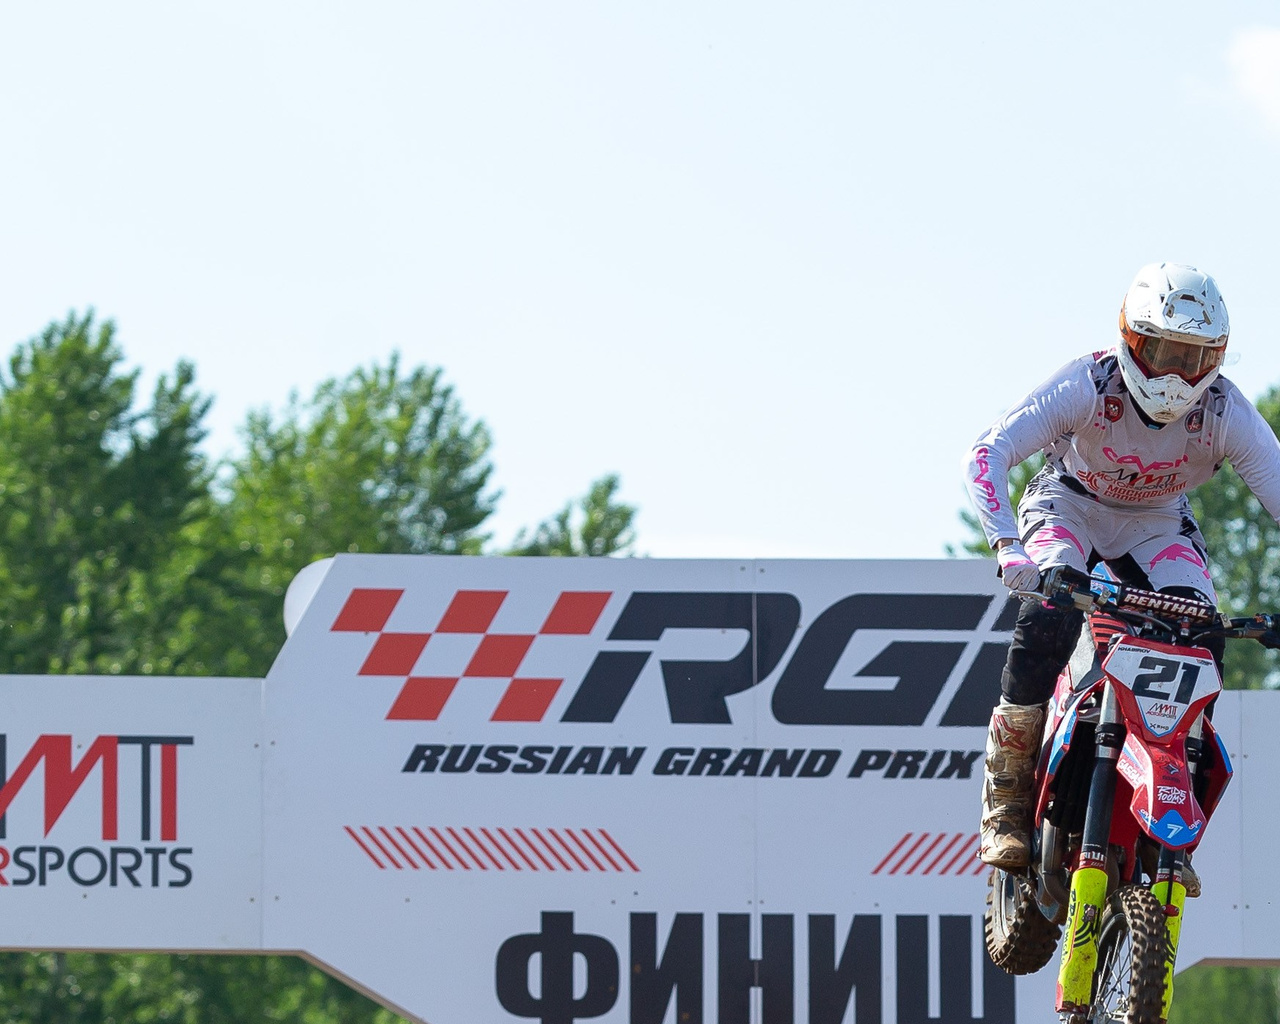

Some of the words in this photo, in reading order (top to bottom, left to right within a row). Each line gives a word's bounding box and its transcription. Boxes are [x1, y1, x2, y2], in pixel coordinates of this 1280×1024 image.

[1124, 593, 1209, 619] RENTHAL
[559, 591, 1015, 726] RG
[1131, 656, 1202, 705] 21
[402, 744, 646, 775] RUSSIAN
[653, 748, 842, 778] GRAND
[848, 750, 984, 779] PRIX
